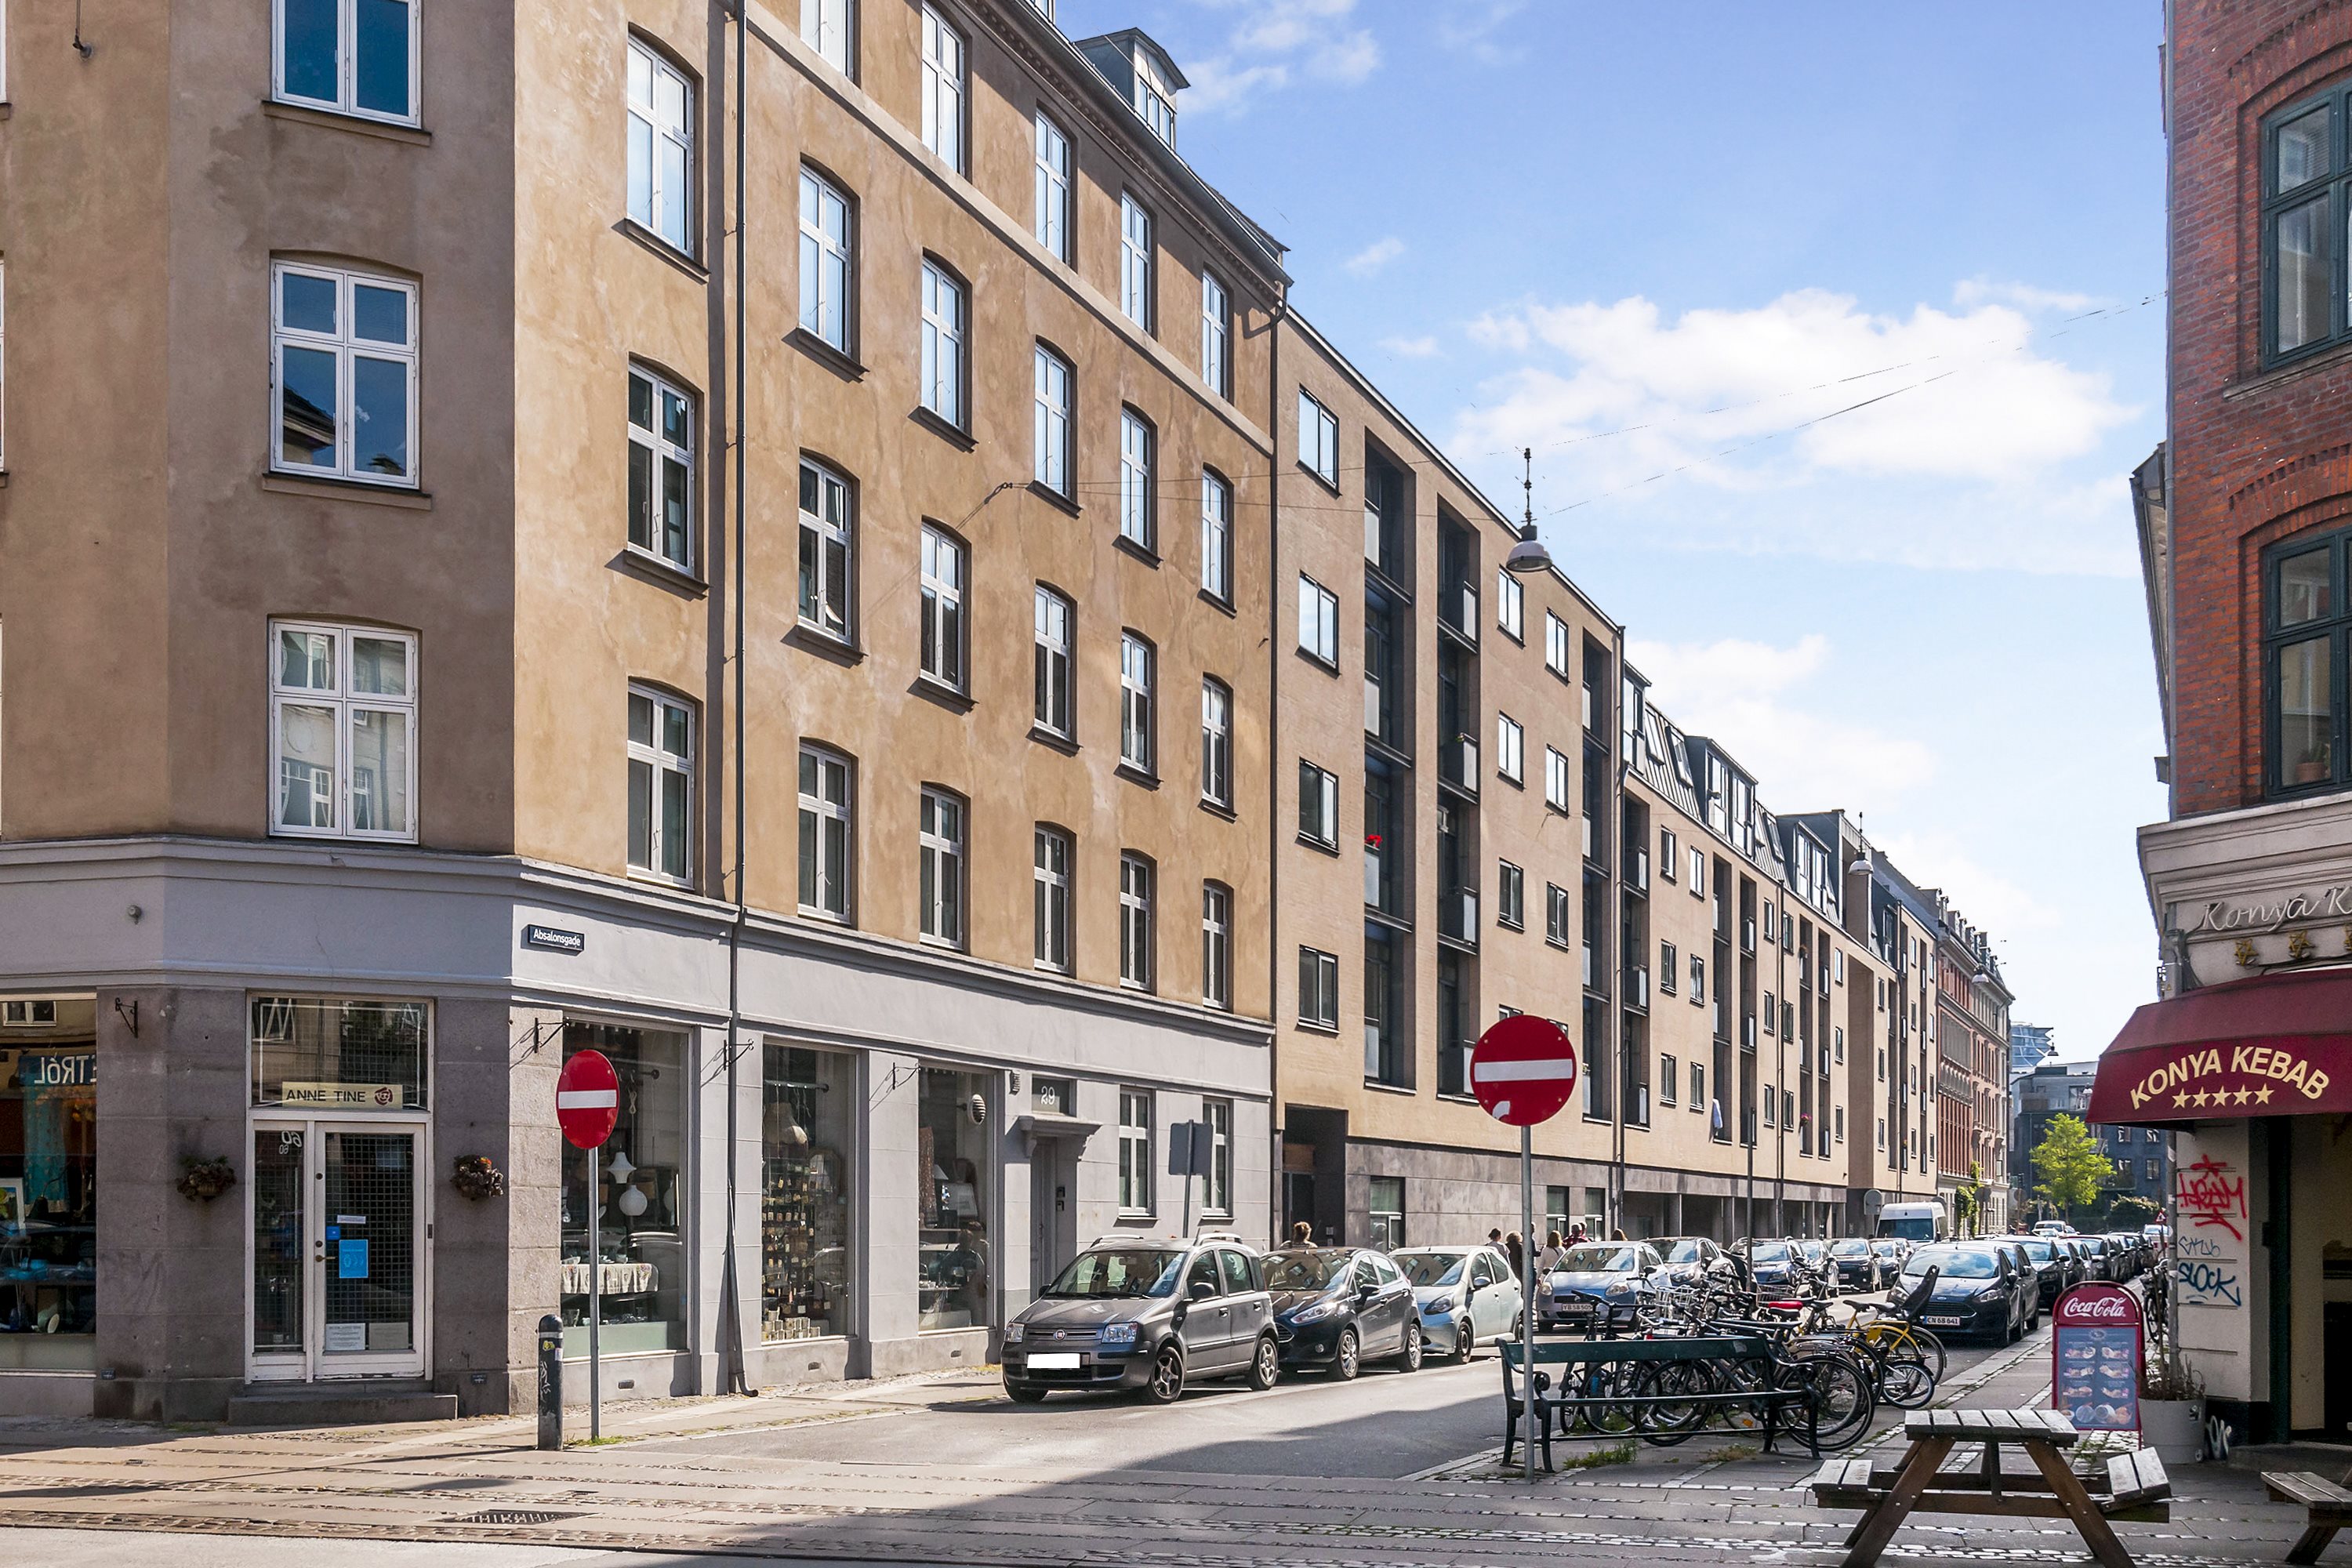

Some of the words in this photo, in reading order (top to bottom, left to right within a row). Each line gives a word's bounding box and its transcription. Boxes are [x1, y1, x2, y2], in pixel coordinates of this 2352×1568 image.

[2203, 898, 2321, 932] Konya
[534, 928, 581, 946] Absalonsgade
[2129, 1048, 2223, 1110] KONYA
[2230, 1046, 2329, 1099] KEBAB
[286, 1089, 326, 1102] ANNE
[334, 1091, 366, 1102] TINE
[1040, 1086, 1055, 1105] 29
[2063, 1297, 2126, 1317] Coca-Cola
